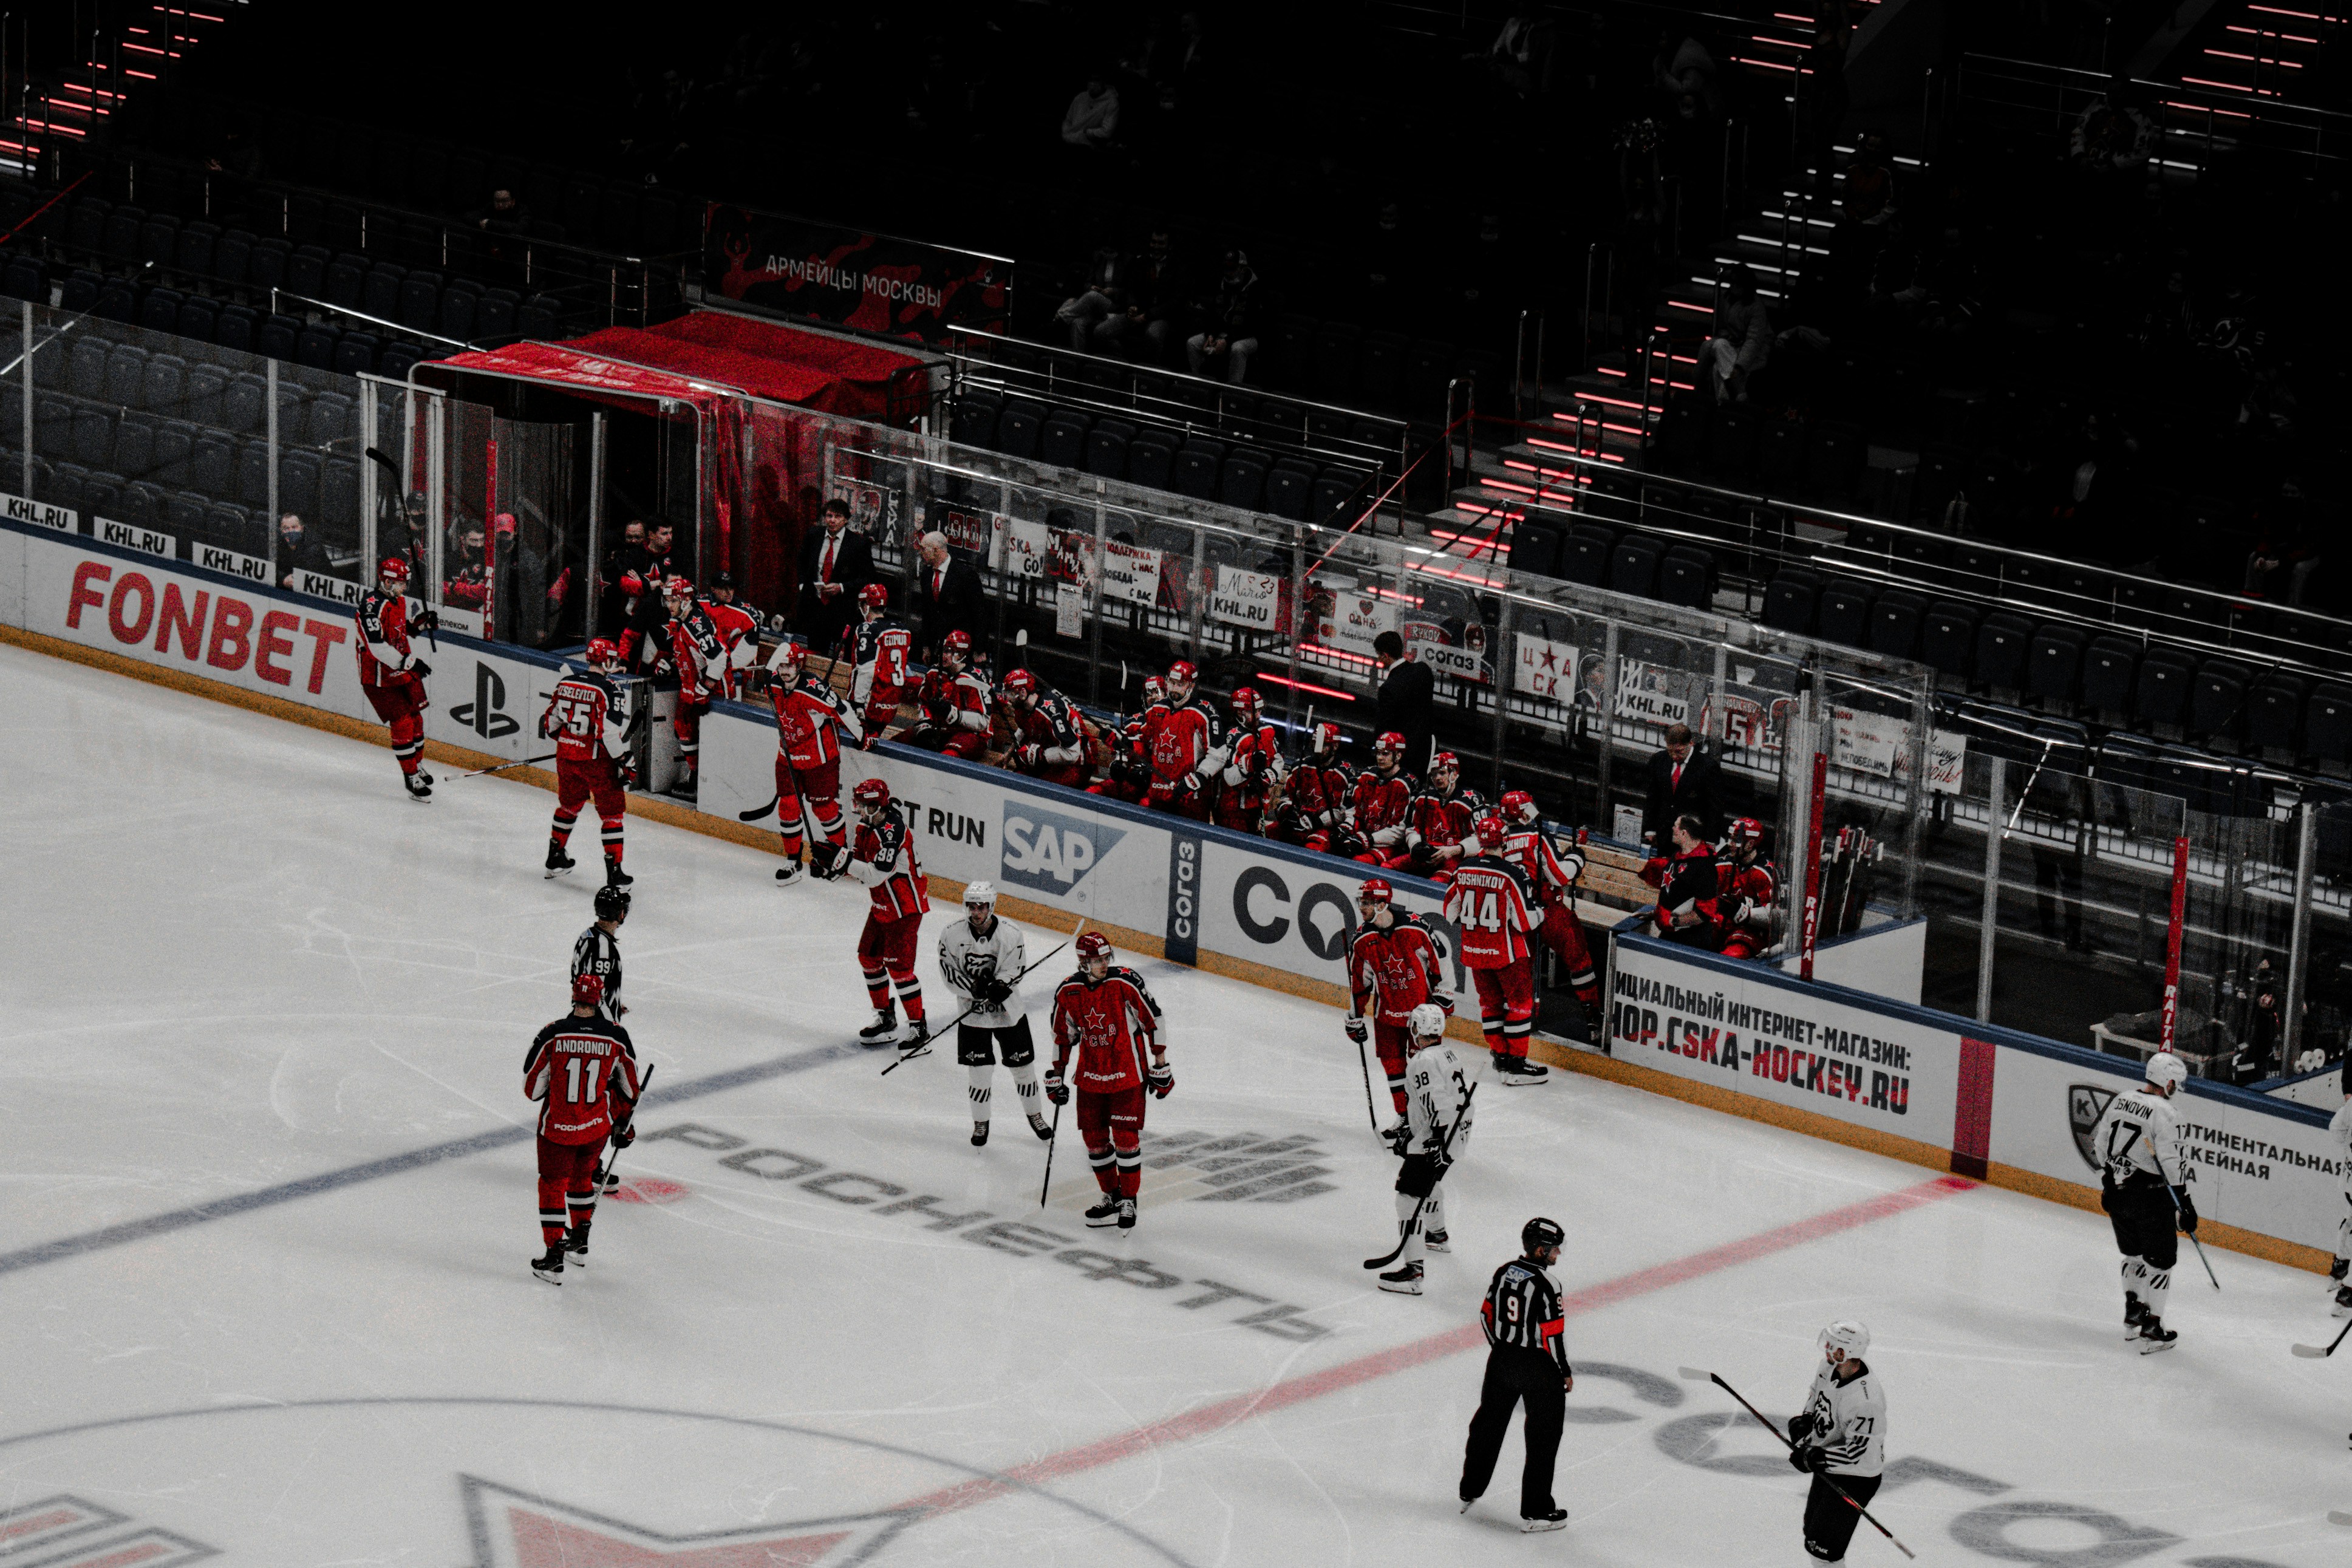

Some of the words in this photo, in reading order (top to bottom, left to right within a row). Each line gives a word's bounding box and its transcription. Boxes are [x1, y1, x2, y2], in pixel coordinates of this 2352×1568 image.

[766, 253, 857, 290] АРМЕЙЦЫ
[862, 274, 941, 308] МОСКВЫ
[7, 499, 68, 529] KHL.RU
[104, 523, 166, 555] KHL.RU
[203, 548, 267, 580] KHL.RU
[1215, 598, 1268, 622] KHL.RU
[66, 561, 347, 695] FONBET
[365, 618, 381, 633] 93
[437, 618, 469, 631] елеком
[698, 633, 715, 652] 37
[859, 637, 868, 652] 3
[890, 648, 905, 687] 3
[1627, 694, 1685, 721] KHL.RU
[1056, 719, 1066, 734] 6
[1212, 720, 1219, 735] 9
[887, 797, 921, 830] ST
[929, 808, 985, 847] RUN
[877, 848, 896, 864] 98
[1003, 817, 1094, 884] SAP
[1457, 871, 1506, 890] SOSHNIKOV
[1460, 889, 1502, 933] 44
[1803, 896, 1817, 962] RAITA
[595, 960, 611, 974] 99
[1615, 970, 1724, 1021] ИЦИАЛЬНЫЙ
[1727, 1002, 1912, 1071] ИНТЕРНЕТ-МАГАЗИН:
[2160, 984, 2176, 1052] RAITA
[554, 1039, 613, 1057] ANDRONOV
[1613, 1001, 1909, 1115] HOP.CSKA-HOCKEY.RU
[565, 1057, 601, 1104] 11
[1414, 1071, 1430, 1089] 38
[1110, 1114, 1139, 1123] BAUER
[2107, 1119, 2142, 1157] 17
[639, 1122, 1331, 1343] РОСНЕФТЬ
[1507, 1267, 1525, 1281] SAP
[1506, 1295, 1519, 1322] 9
[1556, 1297, 1563, 1311] 9
[1855, 1417, 1875, 1434] 71
